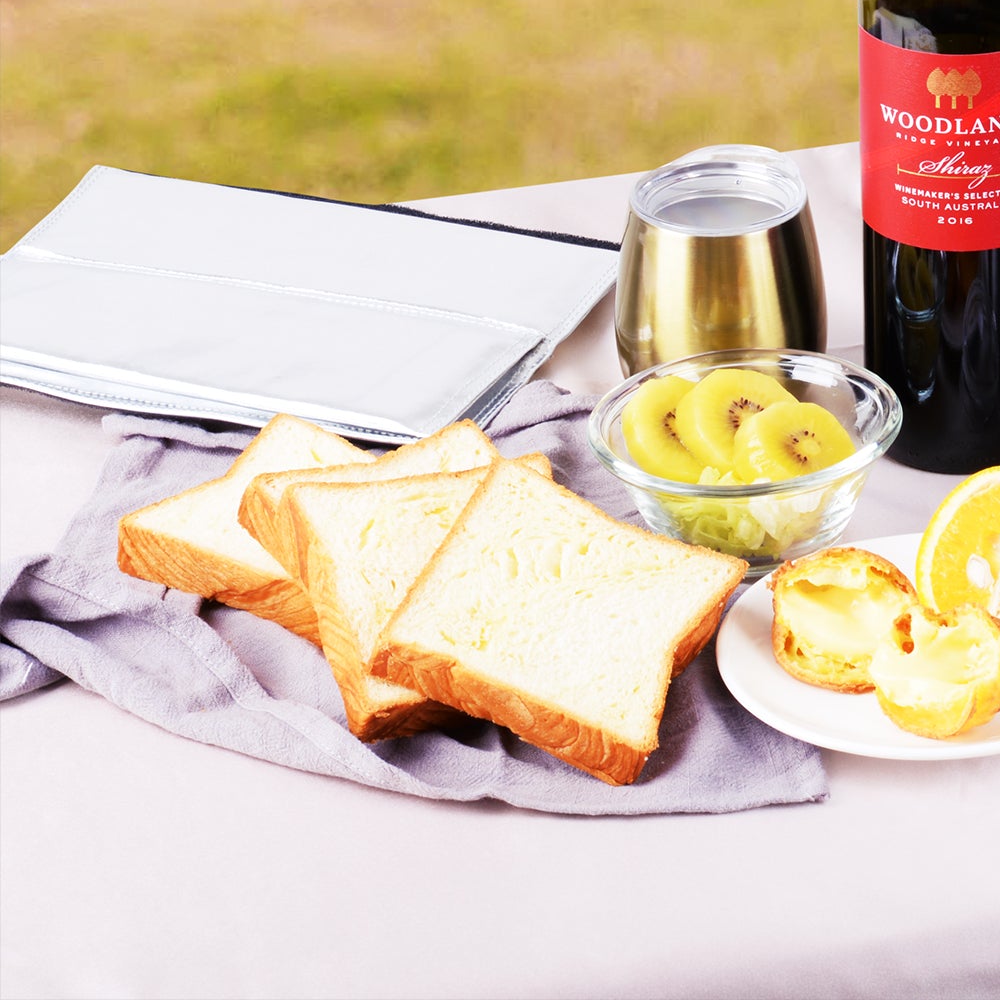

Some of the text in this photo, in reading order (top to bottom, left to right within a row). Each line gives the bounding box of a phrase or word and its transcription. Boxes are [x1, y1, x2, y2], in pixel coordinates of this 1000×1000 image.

[896, 132, 936, 145] RIDGE
[918, 151, 993, 190] Shiraz
[894, 183, 960, 200] WINEMAKER'S
[901, 196, 940, 211] SOUTH
[937, 216, 974, 225] 2016
